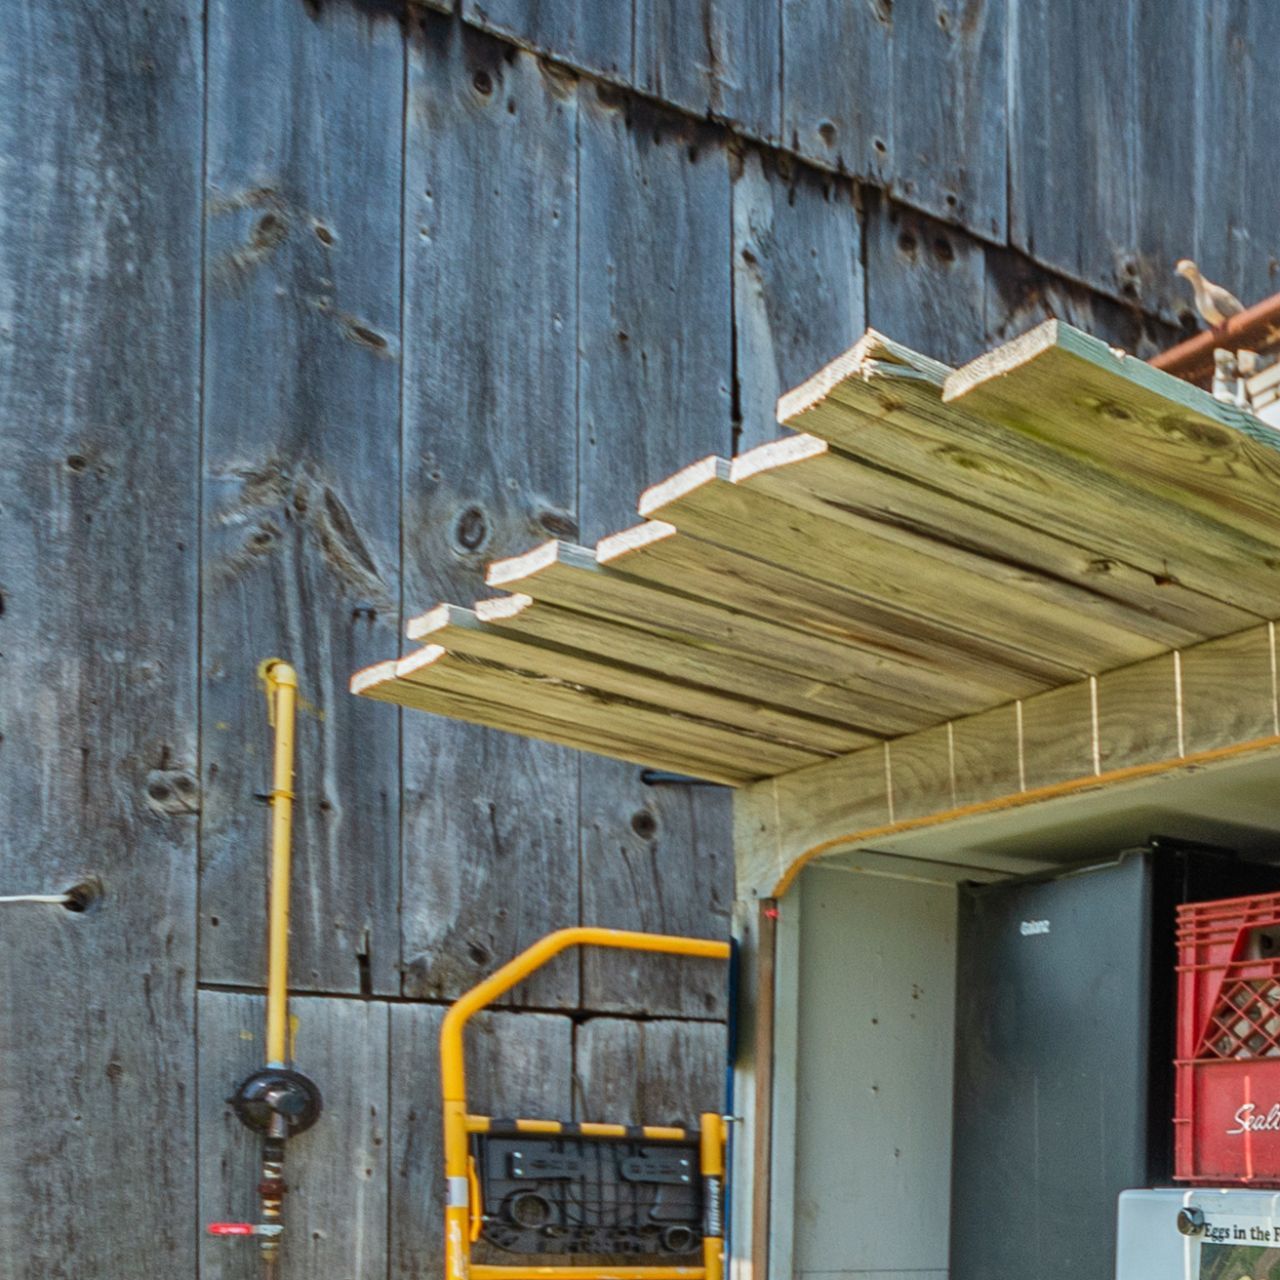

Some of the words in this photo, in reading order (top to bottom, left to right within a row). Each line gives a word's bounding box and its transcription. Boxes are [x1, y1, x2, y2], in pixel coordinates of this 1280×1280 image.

[1203, 1222, 1230, 1242] Eggs
[1233, 1225, 1248, 1240] in
[1250, 1226, 1271, 1241] the
